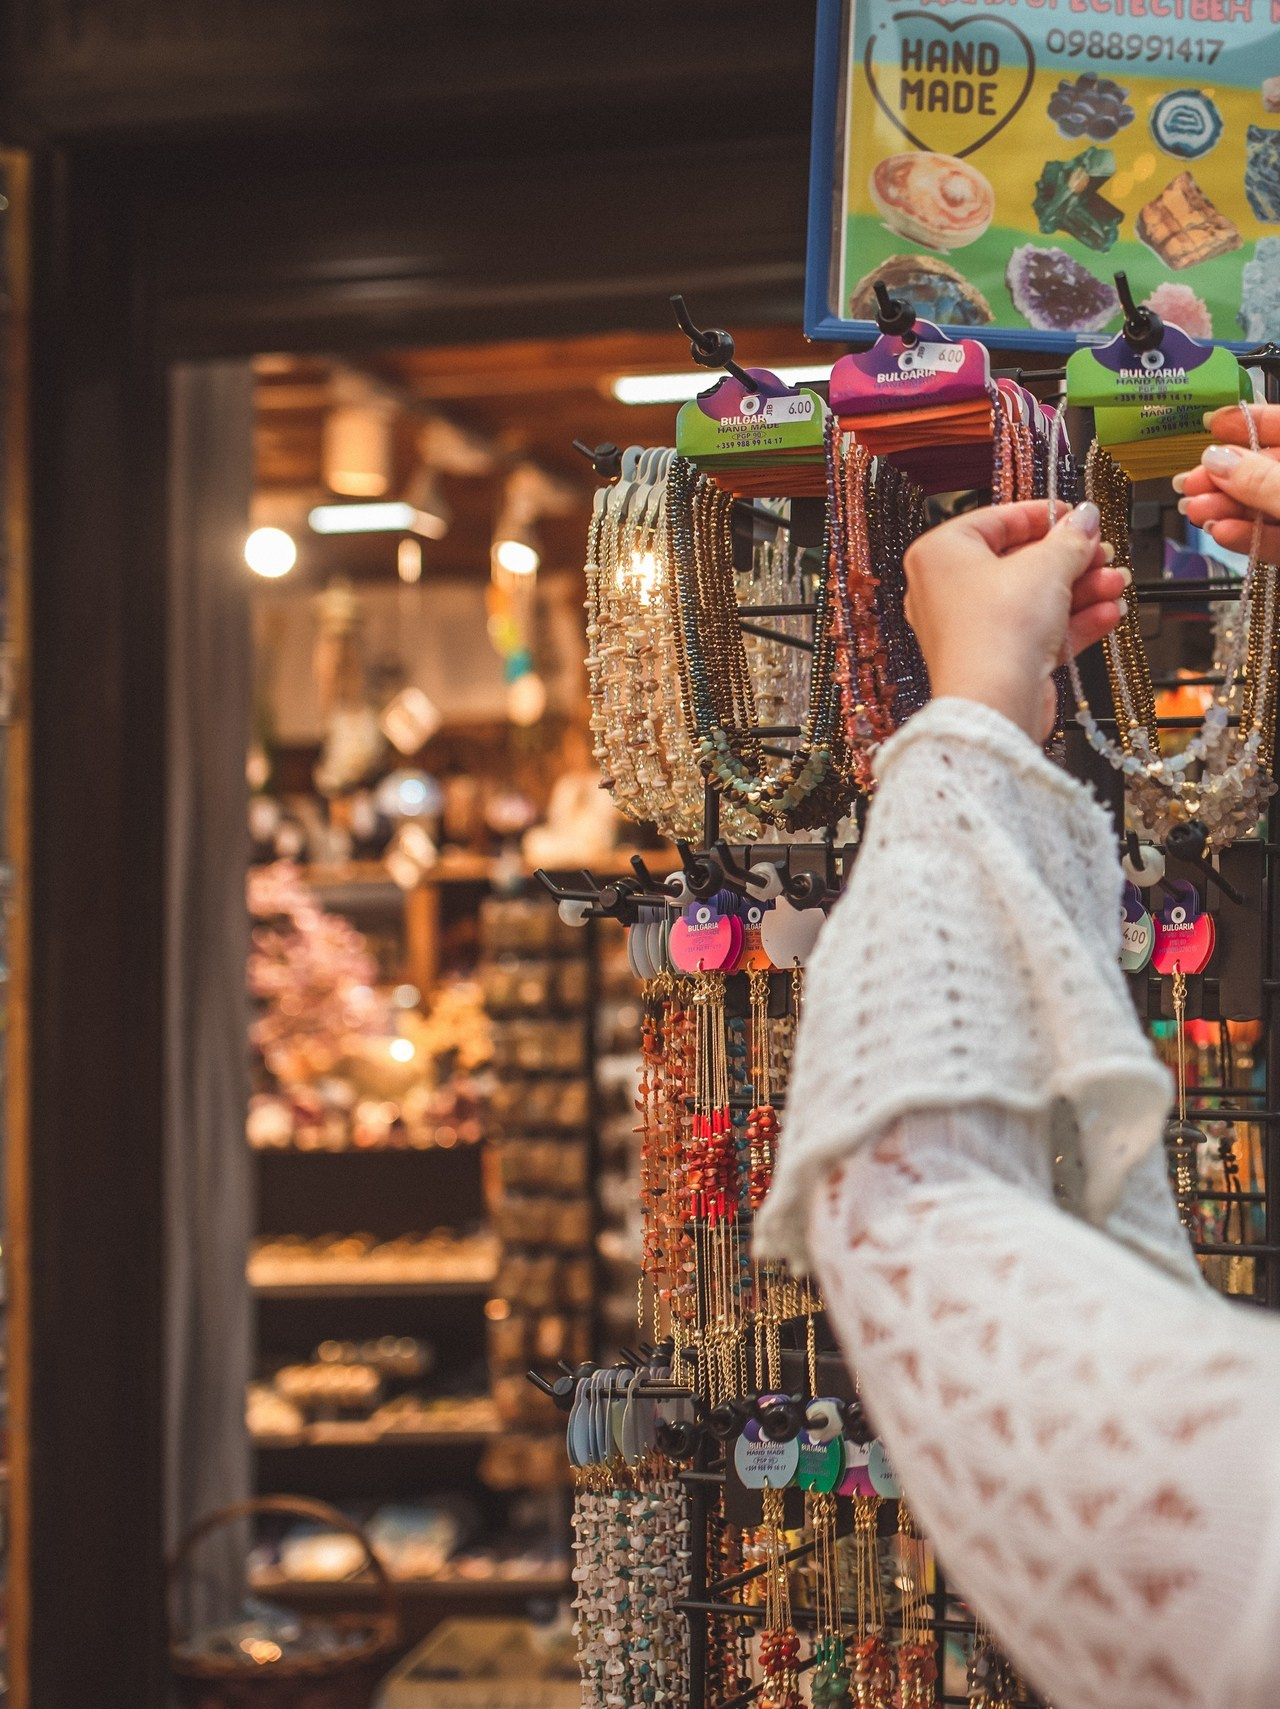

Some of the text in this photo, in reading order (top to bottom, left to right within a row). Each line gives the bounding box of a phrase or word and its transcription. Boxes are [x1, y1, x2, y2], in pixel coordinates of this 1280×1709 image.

[1046, 28, 1224, 65] 0988991417
[902, 38, 999, 77] HAND
[901, 77, 998, 116] MADE
[938, 349, 963, 363] 6.00
[877, 369, 936, 383] BULGARIA
[1119, 367, 1186, 378] BULGARIA
[1155, 377, 1190, 385] MADE
[788, 400, 812, 415] 6.00
[1140, 407, 1173, 418] HAND
[717, 423, 780, 434] HAND MADE
[715, 437, 783, 449] +359 988 99 14 17
[688, 922, 719, 932] BULGARIA
[1162, 922, 1195, 931] BULGARIA
[1122, 927, 1146, 944] 4.00
